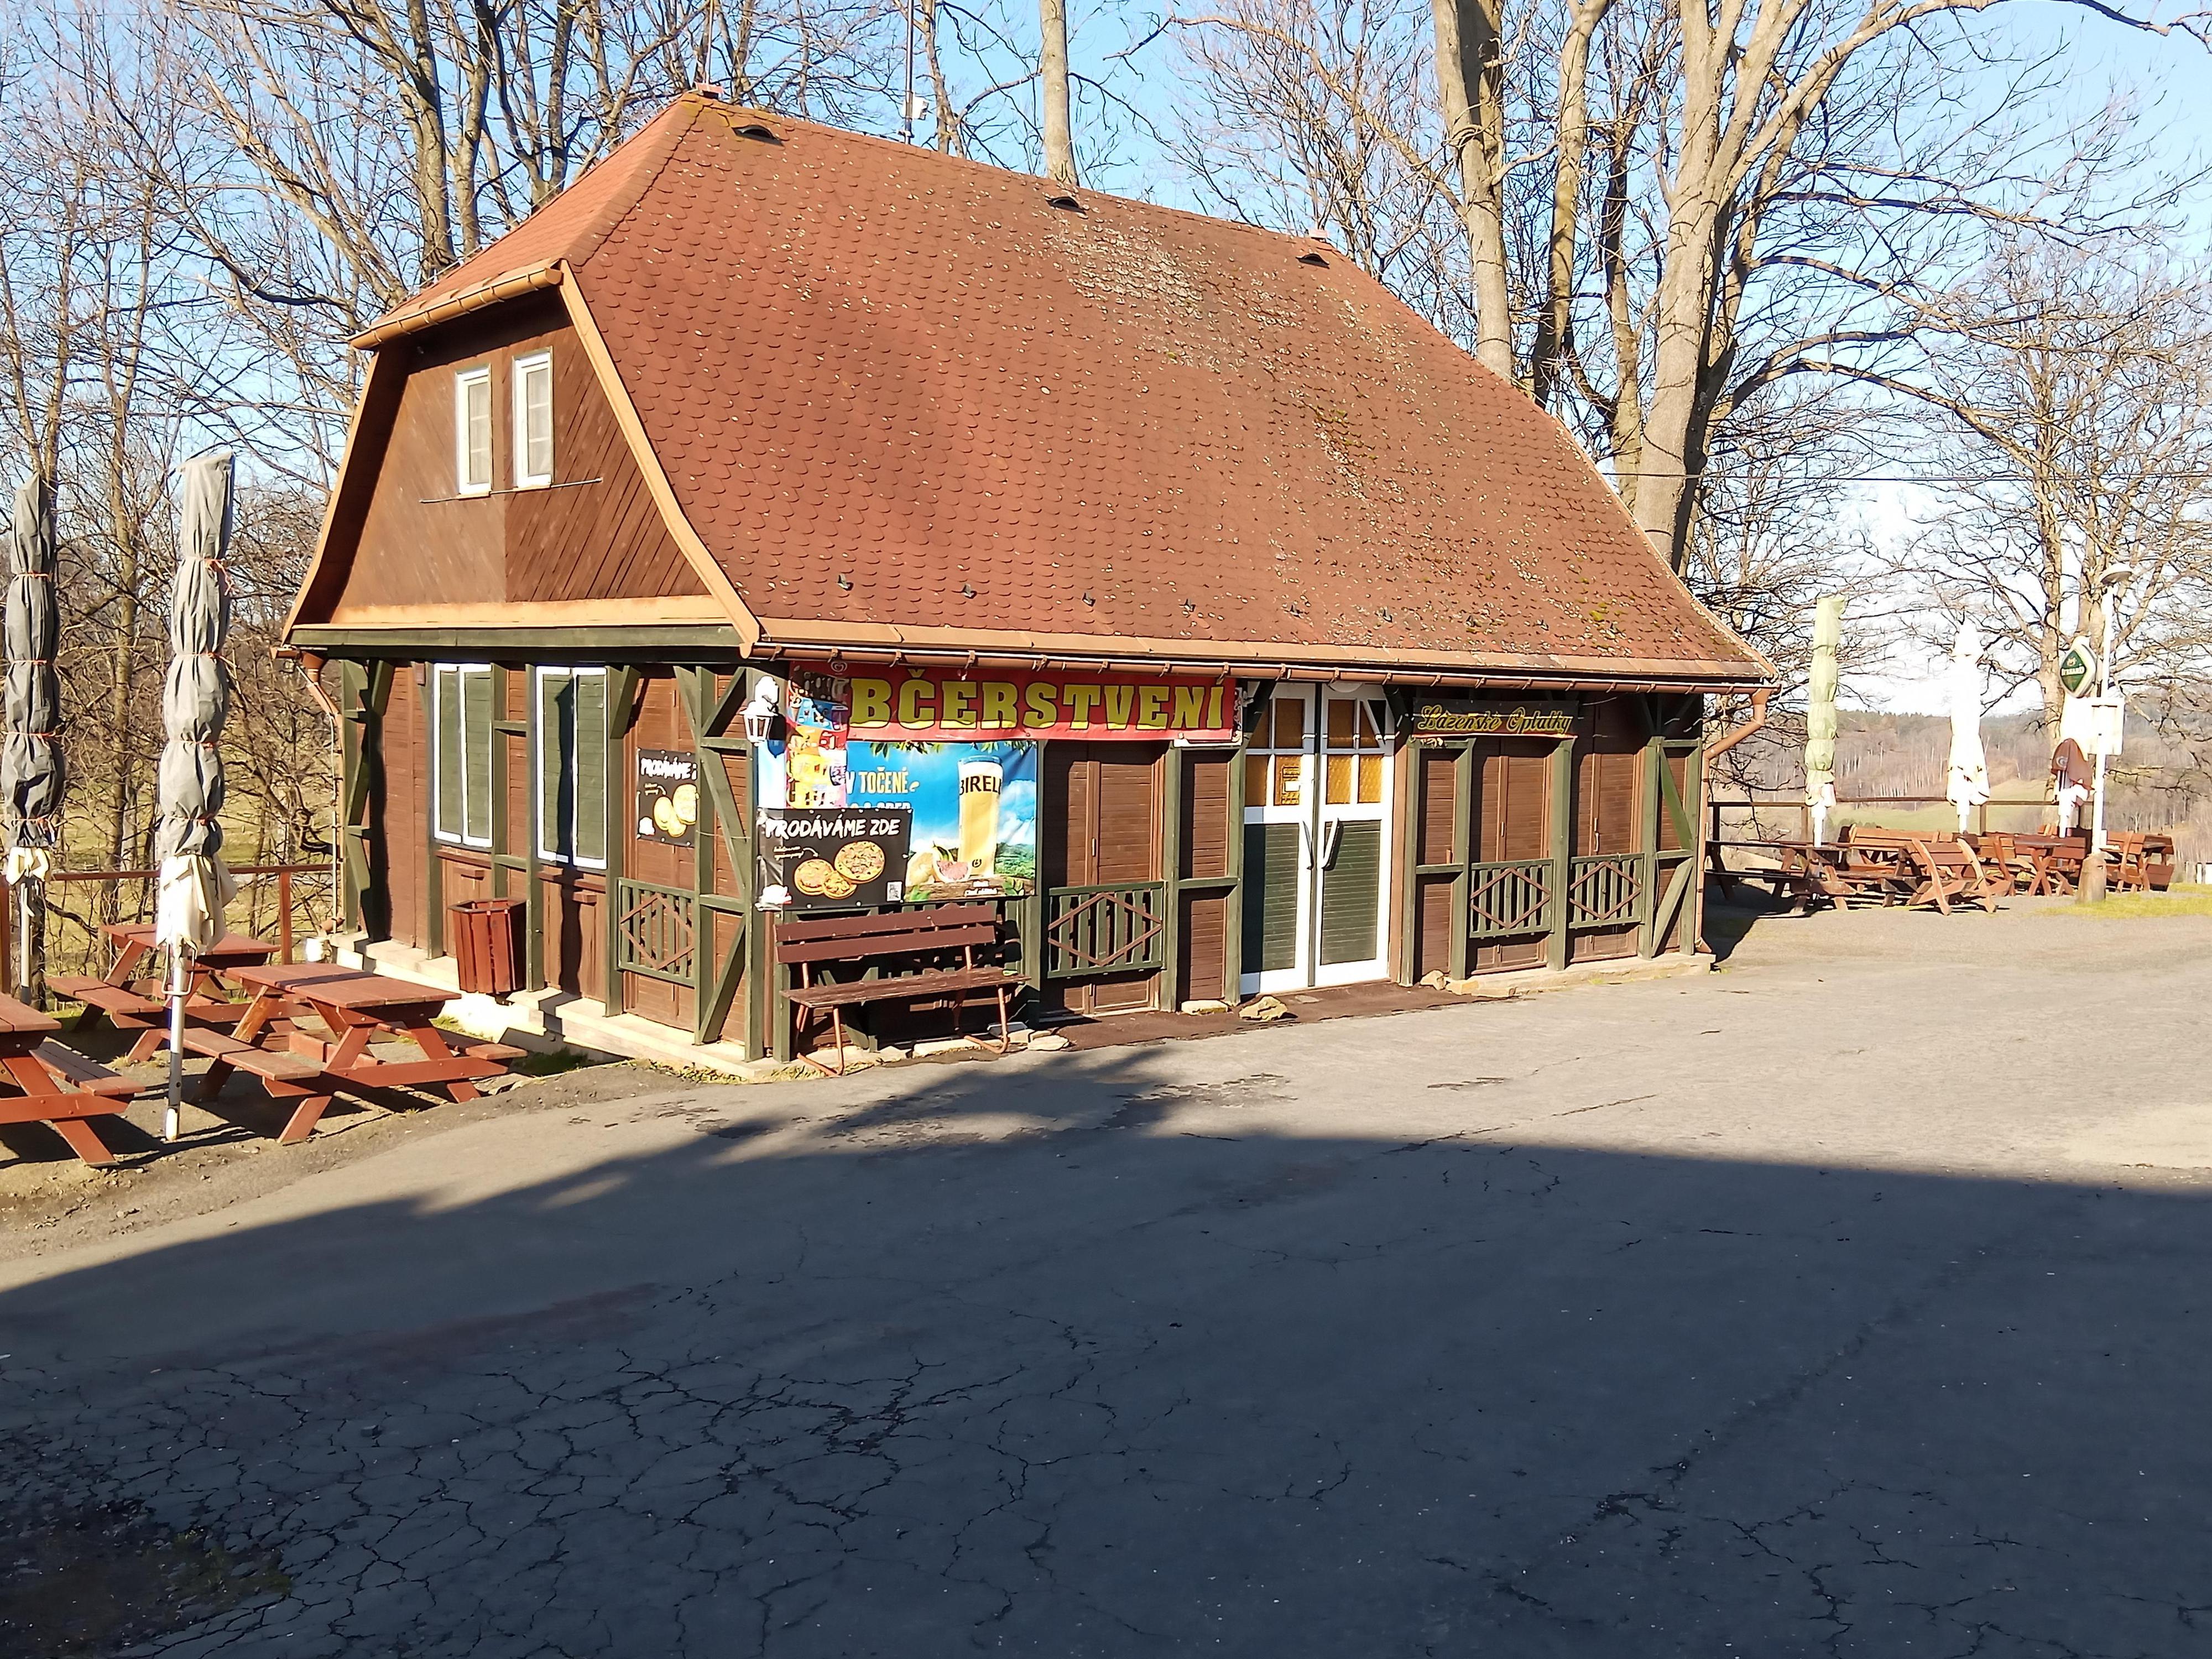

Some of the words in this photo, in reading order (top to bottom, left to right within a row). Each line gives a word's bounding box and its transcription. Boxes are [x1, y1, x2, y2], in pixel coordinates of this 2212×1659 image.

[849, 668, 1225, 730] BČERSTVENÍ
[1506, 706, 1573, 735] Oplatky
[858, 766, 909, 794] TOČENÉ
[765, 813, 867, 840] PRODÁVÁME
[869, 818, 901, 836] ZDE
